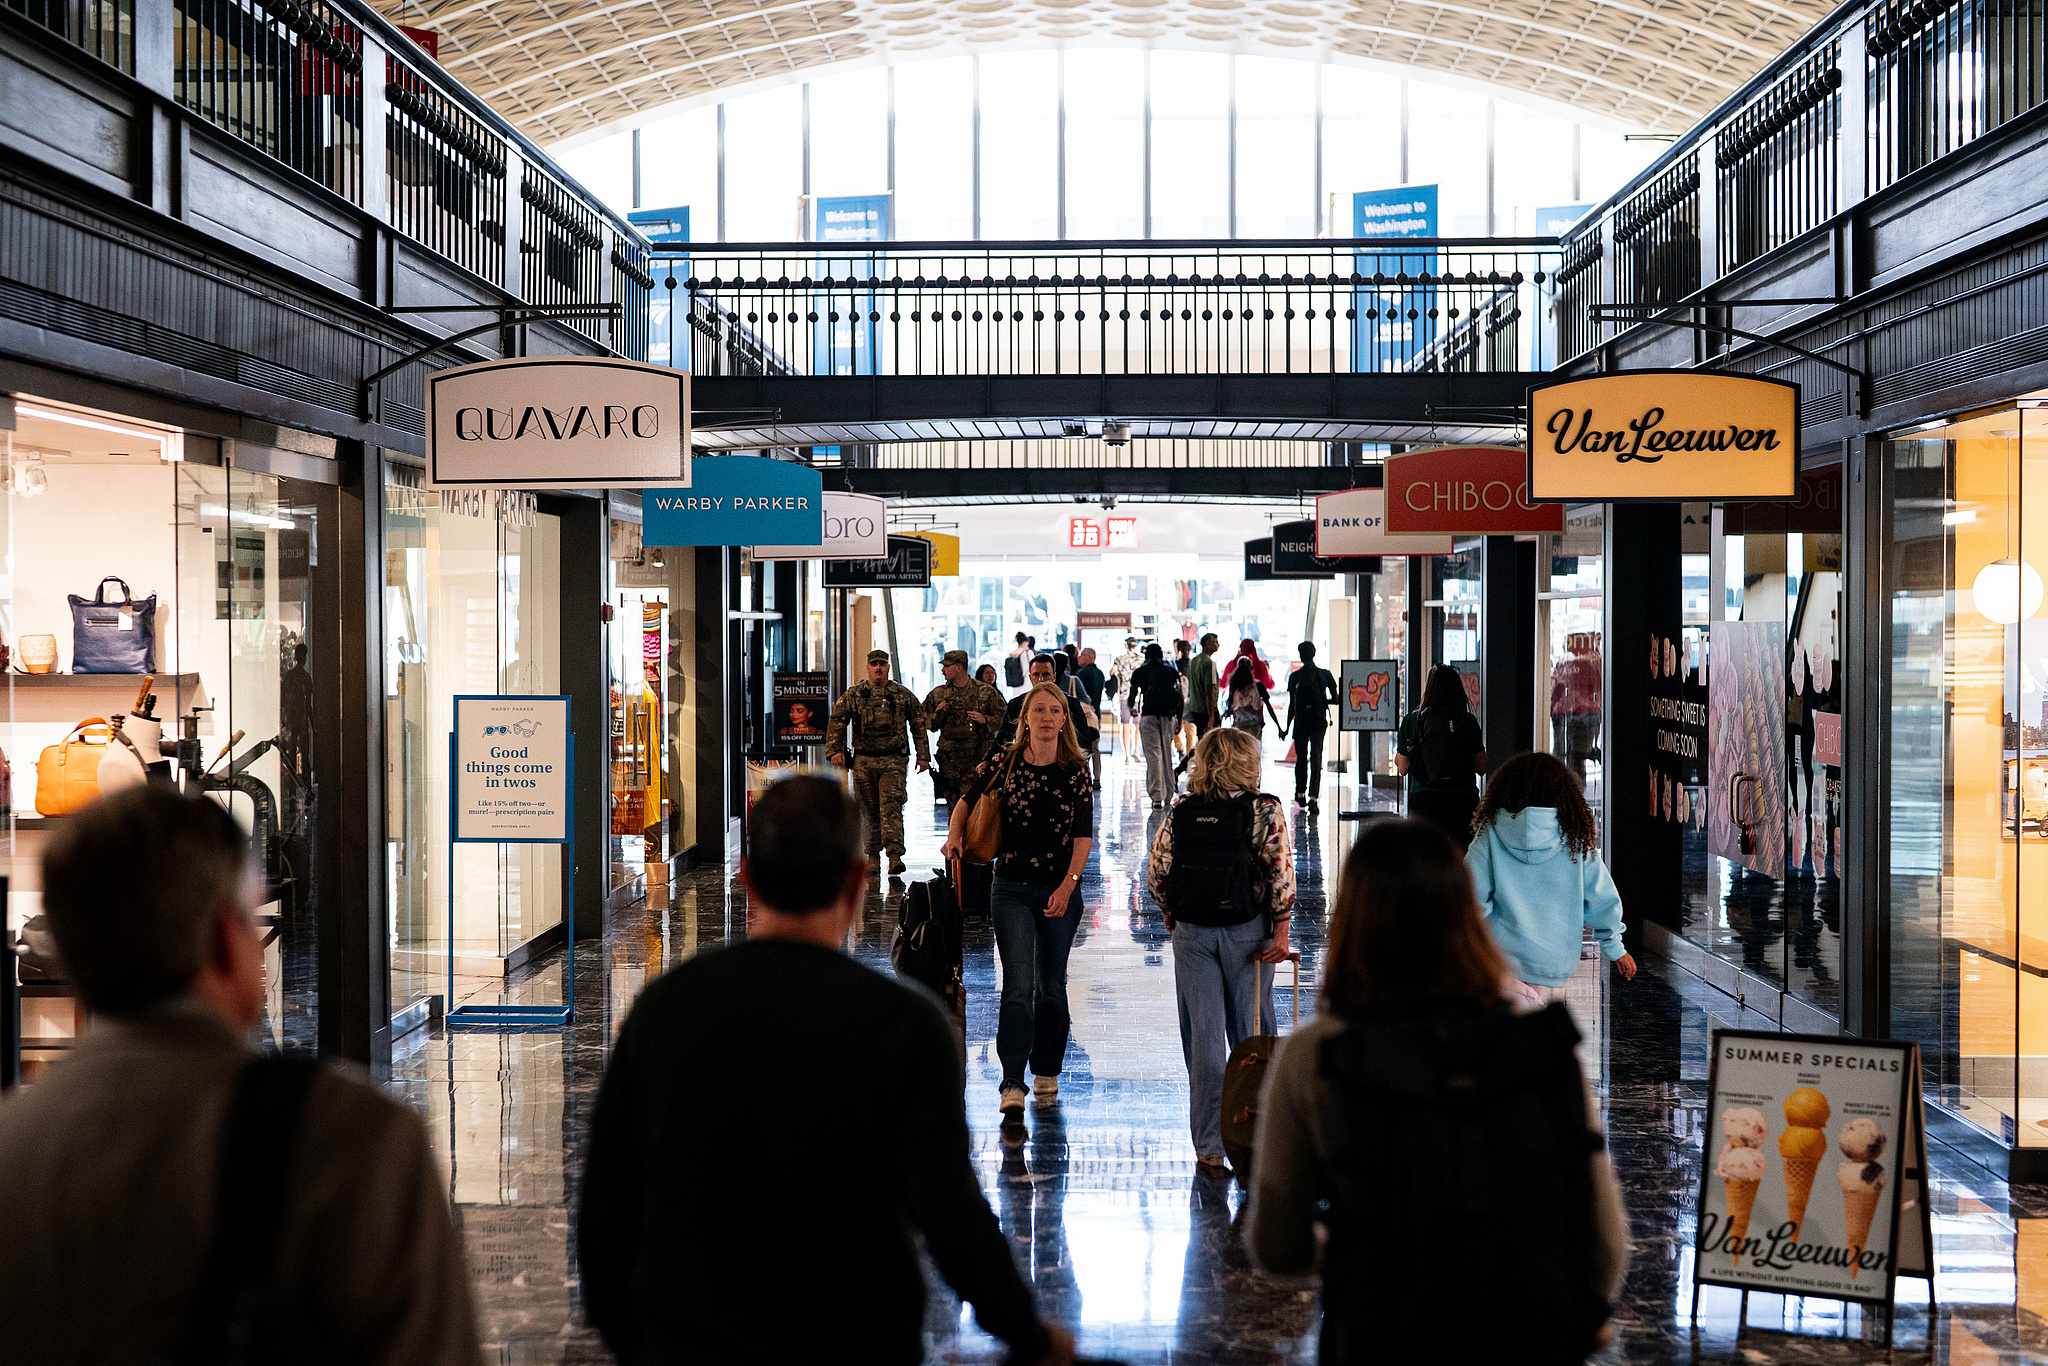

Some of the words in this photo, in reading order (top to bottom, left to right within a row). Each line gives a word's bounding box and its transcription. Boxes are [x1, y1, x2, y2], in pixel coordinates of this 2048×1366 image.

[825, 210, 866, 222] Welcome
[867, 210, 878, 221] to
[1364, 203, 1412, 217] Welcome
[1413, 201, 1427, 213] to
[824, 226, 878, 241] Washington
[1364, 218, 1427, 234] Washington
[455, 404, 659, 441] QUAVARO
[656, 497, 724, 510] WARBY
[734, 497, 809, 510] PARKER
[822, 510, 874, 539] bro
[1323, 518, 1360, 527] BANK
[1364, 517, 1381, 527] OF
[1280, 542, 1316, 552] NEIGH
[1250, 554, 1272, 564] NEIG
[774, 685, 783, 697] 5
[783, 686, 829, 695] MINUTES
[1651, 696, 1681, 722] SOMETHING
[1681, 701, 1700, 725] SWEET
[1657, 729, 1680, 754] COMING
[1681, 734, 1698, 758] SOON
[490, 746, 529, 758] Good
[466, 761, 510, 776] things
[513, 764, 553, 773] come
[485, 776, 500, 788] in
[504, 777, 536, 788] twos
[537, 808, 555, 817] pairs
[1725, 1047, 1804, 1065] SUMMER
[1811, 1054, 1900, 1073] SPECIALS
[1718, 1269, 1734, 1277] LIFE
[1736, 1271, 1772, 1280] WITHOUT
[1774, 1276, 1815, 1286] ANYTHING
[1816, 1280, 1842, 1289] GOOD
